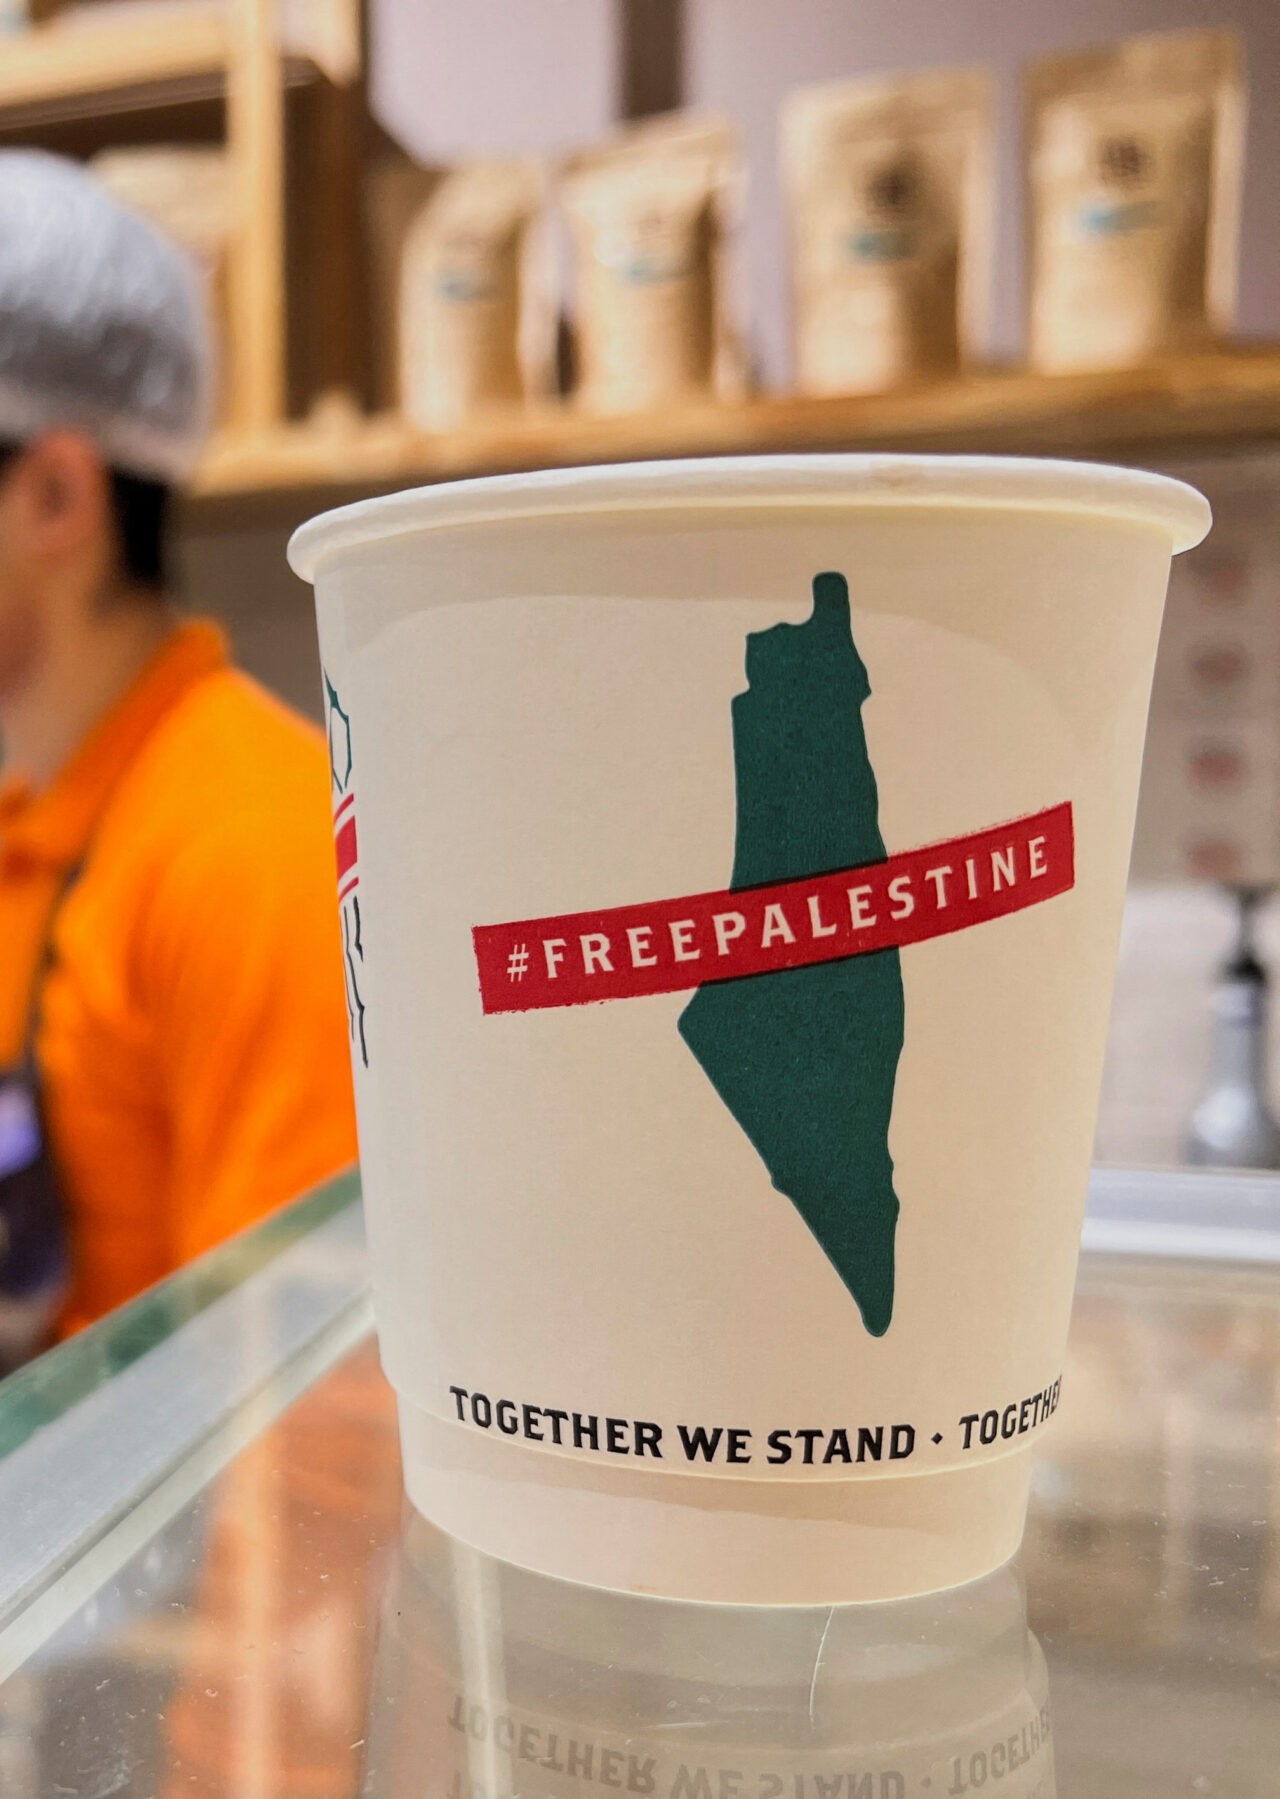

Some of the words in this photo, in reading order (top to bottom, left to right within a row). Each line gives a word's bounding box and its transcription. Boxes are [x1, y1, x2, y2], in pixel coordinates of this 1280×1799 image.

[506, 835, 1049, 983] #FREEPALESTINE
[449, 1385, 664, 1458] TOGETHER
[676, 1424, 753, 1464] WE
[766, 1423, 916, 1465] STAND
[958, 1374, 1063, 1450] TOGETHE
